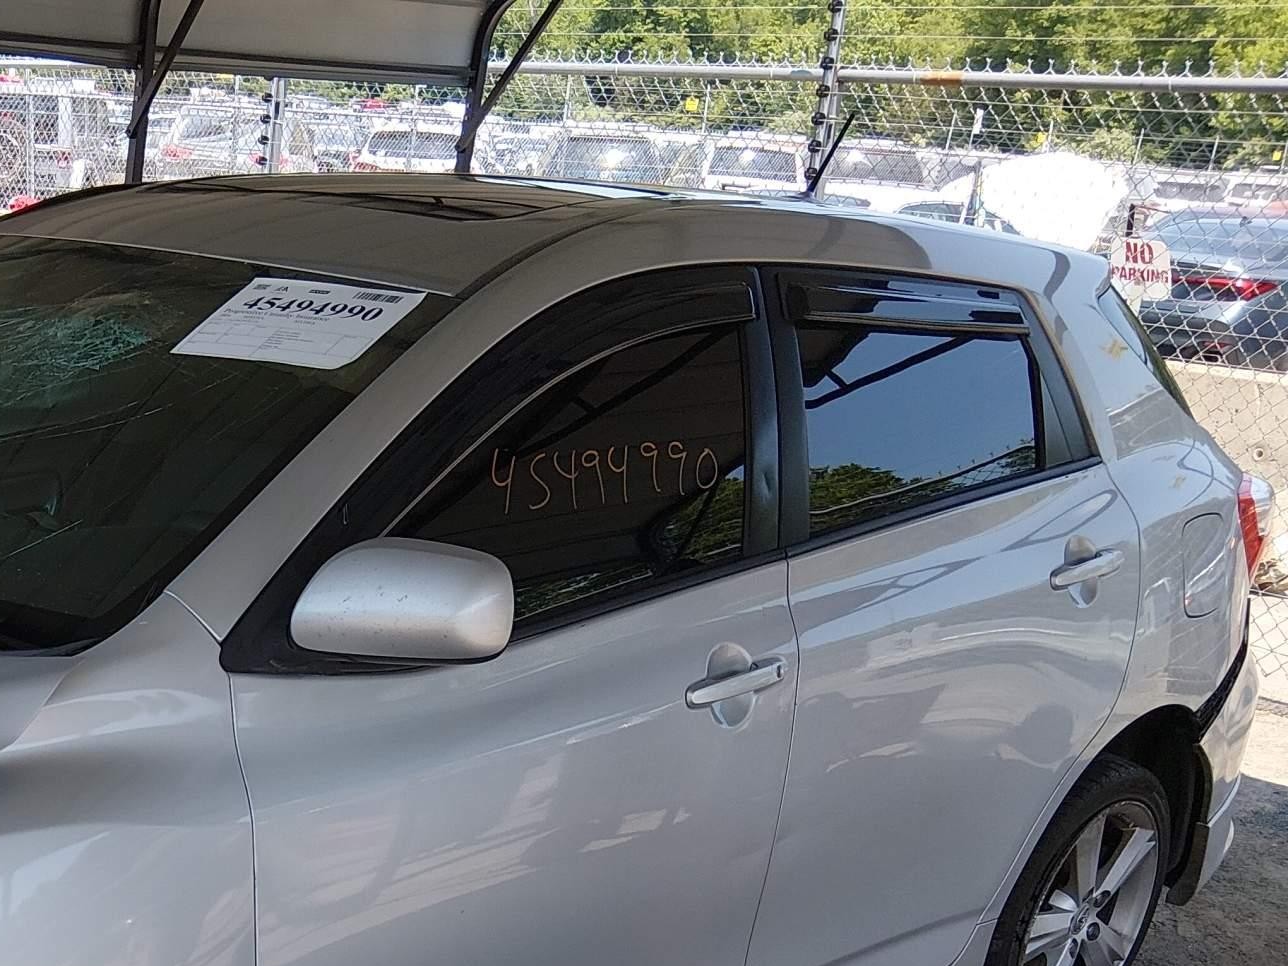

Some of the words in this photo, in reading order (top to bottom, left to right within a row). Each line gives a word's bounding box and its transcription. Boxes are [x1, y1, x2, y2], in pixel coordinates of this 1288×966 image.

[1125, 241, 1154, 264] NO
[1112, 265, 1169, 283] PARKING
[243, 296, 384, 321] 45494990
[491, 441, 719, 515] 45494990
